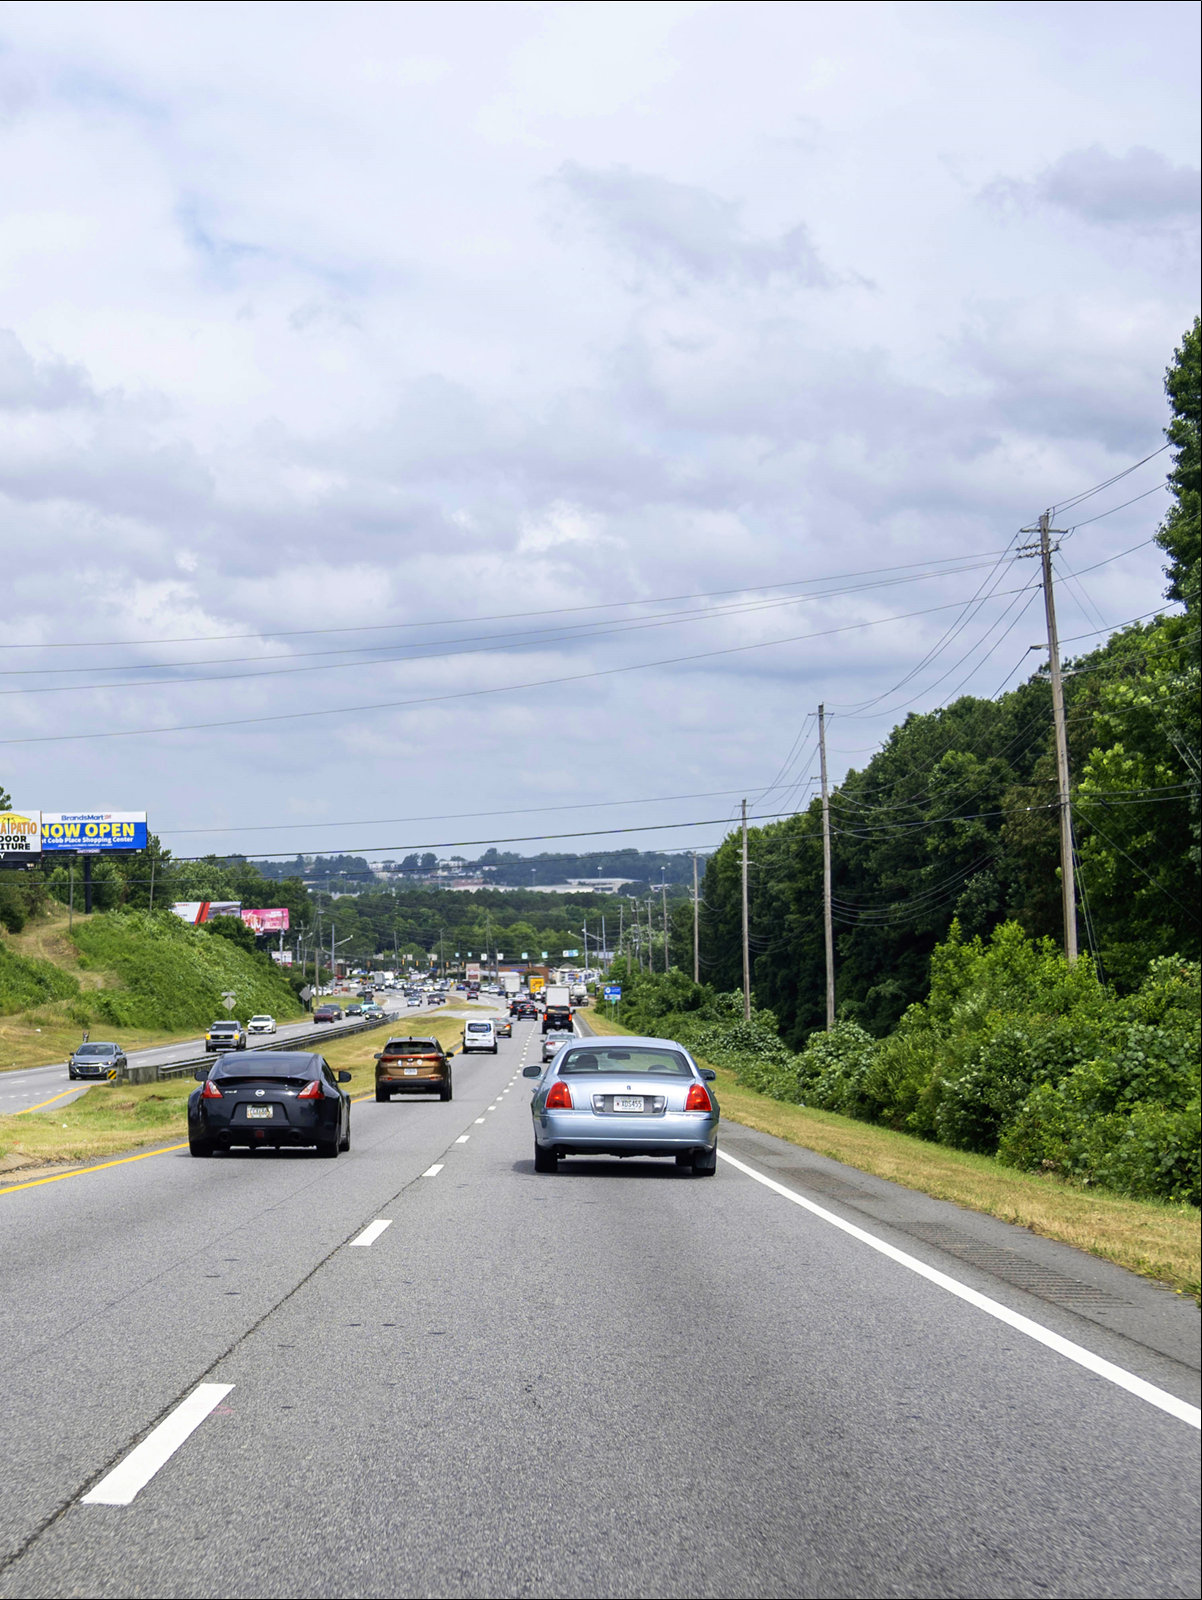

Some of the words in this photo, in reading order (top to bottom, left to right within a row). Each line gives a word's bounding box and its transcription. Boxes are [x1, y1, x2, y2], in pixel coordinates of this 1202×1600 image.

[11, 822, 37, 835] PATIO
[42, 823, 80, 838] NOW
[85, 823, 135, 837] OPEN
[82, 836, 112, 844] Shopping
